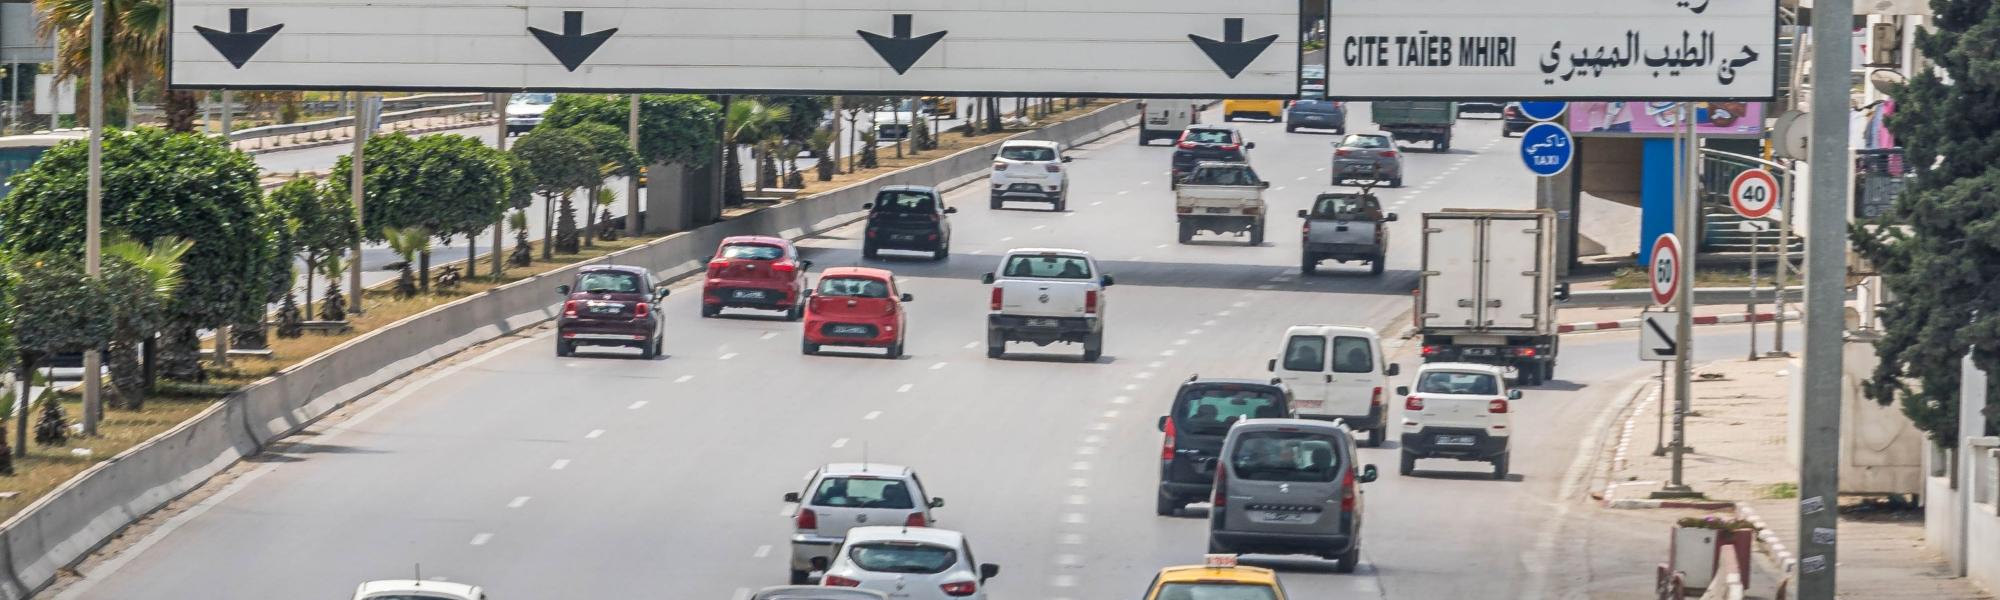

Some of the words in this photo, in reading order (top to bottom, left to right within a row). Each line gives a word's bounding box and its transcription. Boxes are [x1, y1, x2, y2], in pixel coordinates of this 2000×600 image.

[1343, 36, 1389, 67] CITE
[1459, 36, 1516, 67] MHIRI
[1538, 29, 1640, 86] المهيري
[1643, 29, 1715, 78] الطيب
[1526, 134, 1567, 155] تاكسي
[1533, 155, 1560, 166] TAXI
[1742, 185, 1766, 203] 40
